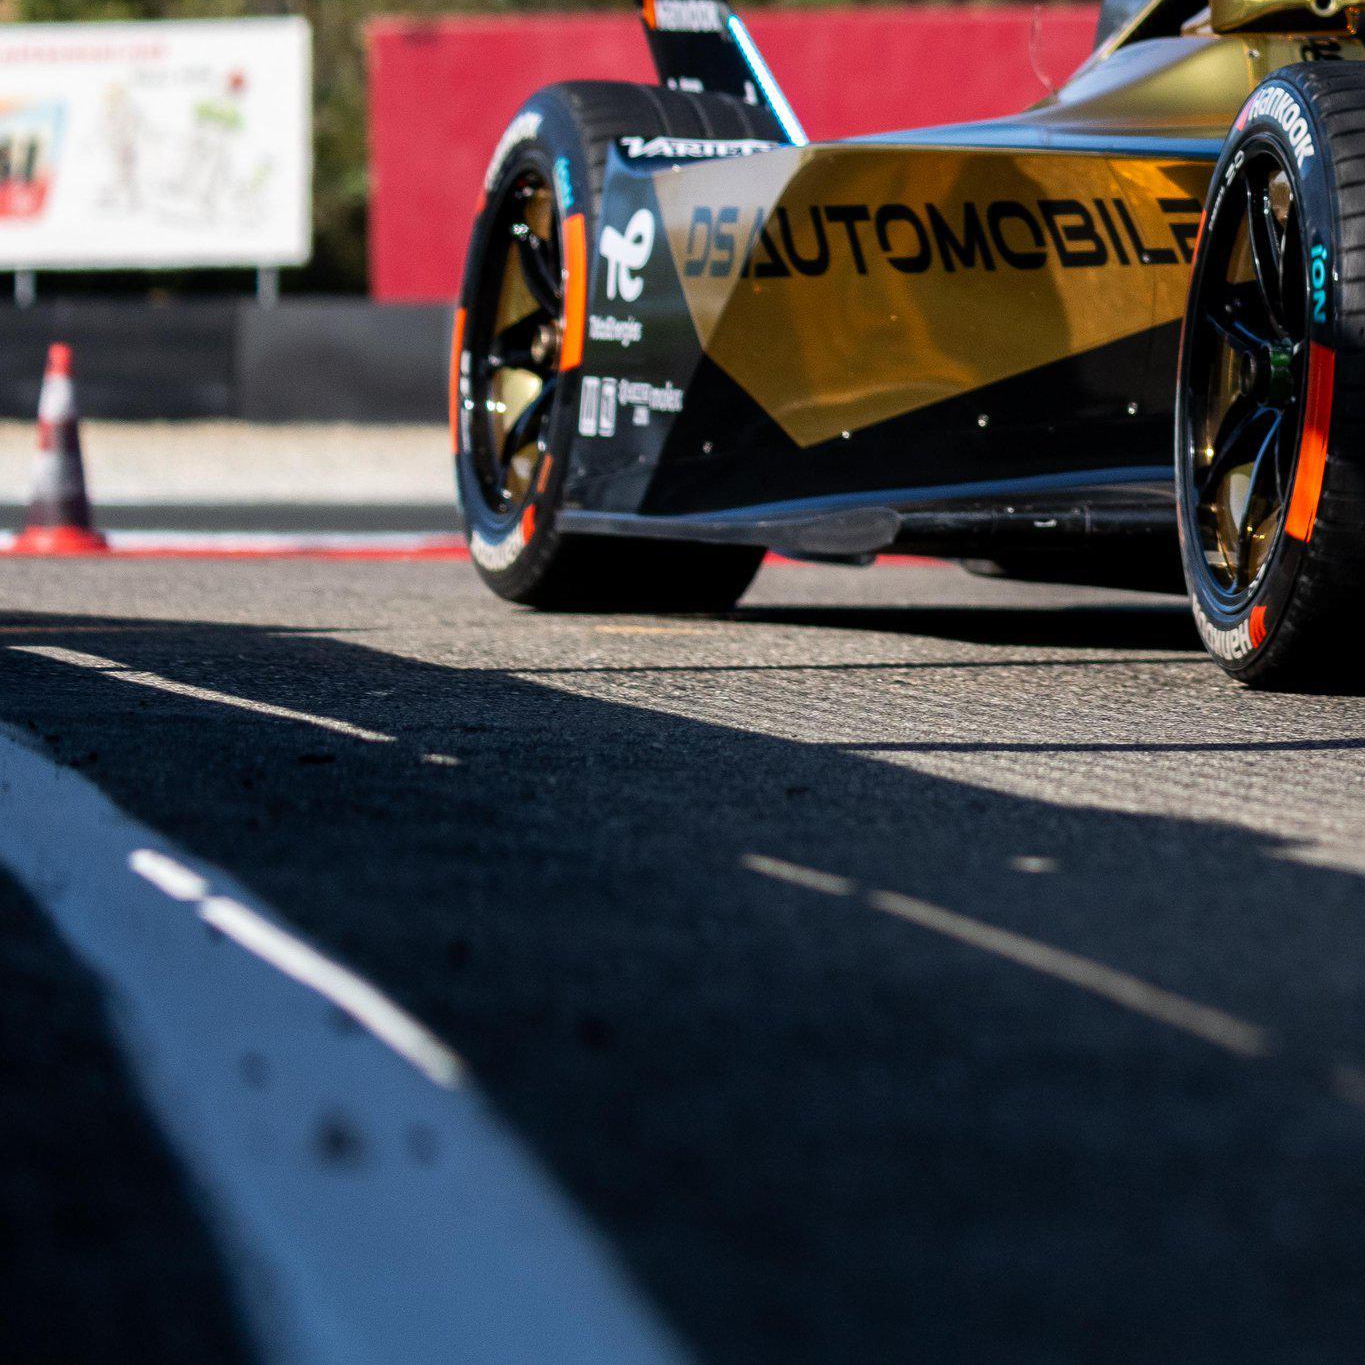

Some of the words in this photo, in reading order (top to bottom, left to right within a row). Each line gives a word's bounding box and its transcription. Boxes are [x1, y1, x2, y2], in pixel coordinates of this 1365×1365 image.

[1248, 87, 1315, 169] Hankook
[684, 205, 739, 277] DS
[740, 198, 1203, 278] AUTOMOBILE
